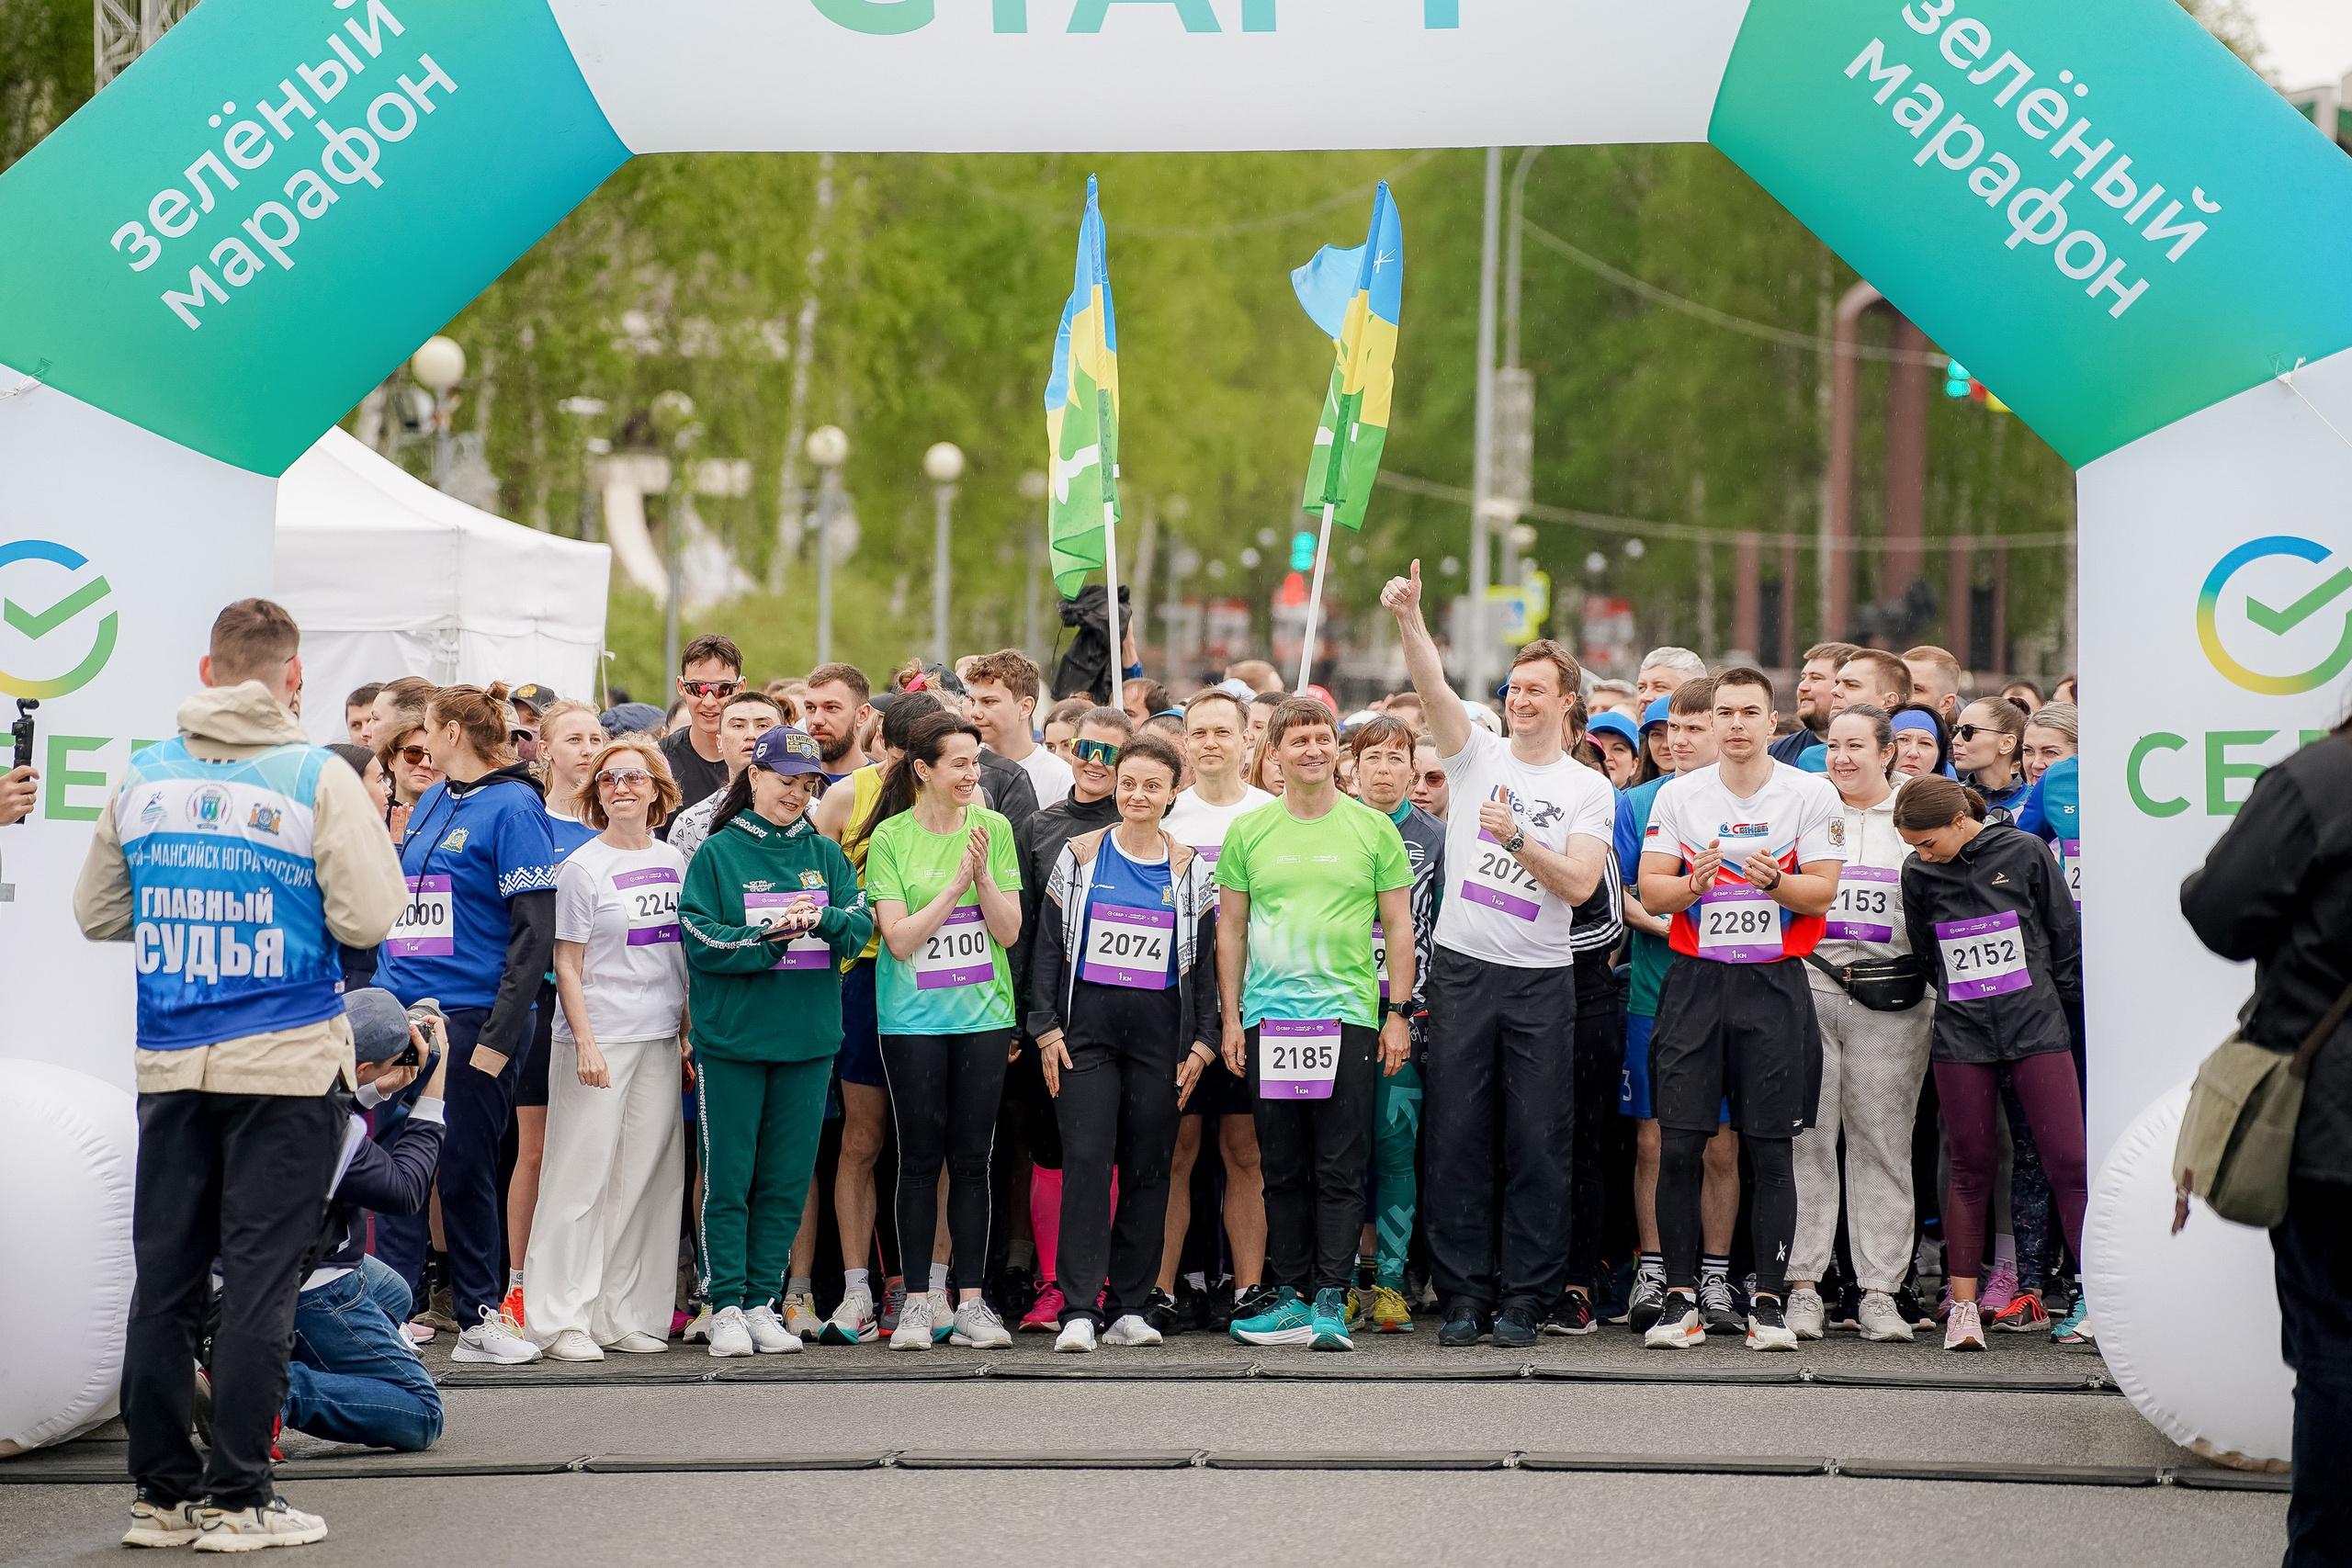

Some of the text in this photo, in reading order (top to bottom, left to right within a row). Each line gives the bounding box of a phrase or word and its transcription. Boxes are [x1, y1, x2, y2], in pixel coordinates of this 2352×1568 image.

[110, 0, 406, 273] зелёный
[1901, 0, 2222, 264] зелёный
[160, 52, 458, 332] марафон
[1843, 37, 2151, 320] марафон
[141, 886, 274, 924] ГЛАВНЫЙ
[1709, 910, 1771, 935] 2289
[135, 921, 285, 986] СУДЬЯ
[926, 931, 985, 960] 2100
[1098, 931, 1162, 960] 2074
[1952, 940, 2016, 971] 2152
[1272, 1046, 1332, 1070] 2185
